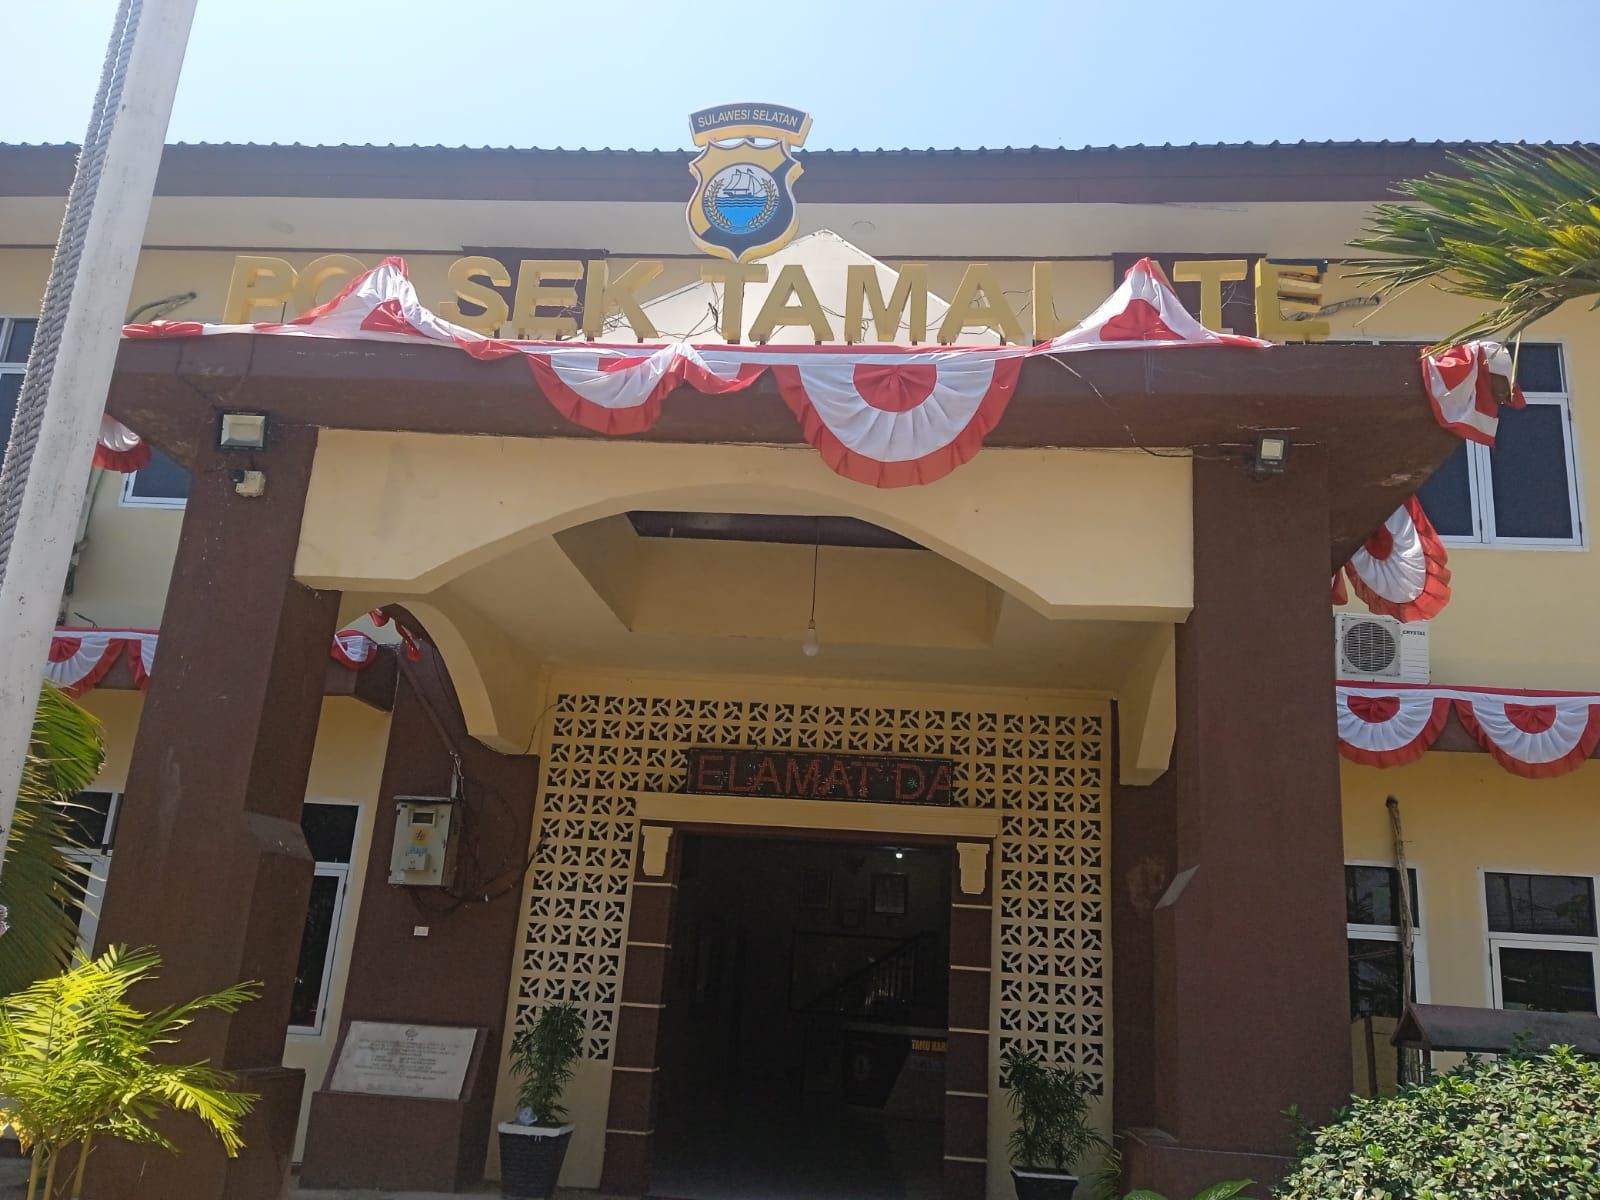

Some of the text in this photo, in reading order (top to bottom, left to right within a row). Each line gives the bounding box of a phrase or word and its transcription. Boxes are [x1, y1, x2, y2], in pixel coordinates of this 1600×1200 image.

[698, 109, 799, 127] SULAWESI SELATAN
[223, 254, 1330, 342] POSEK TAMALTE
[697, 754, 879, 797] ELAMAT
